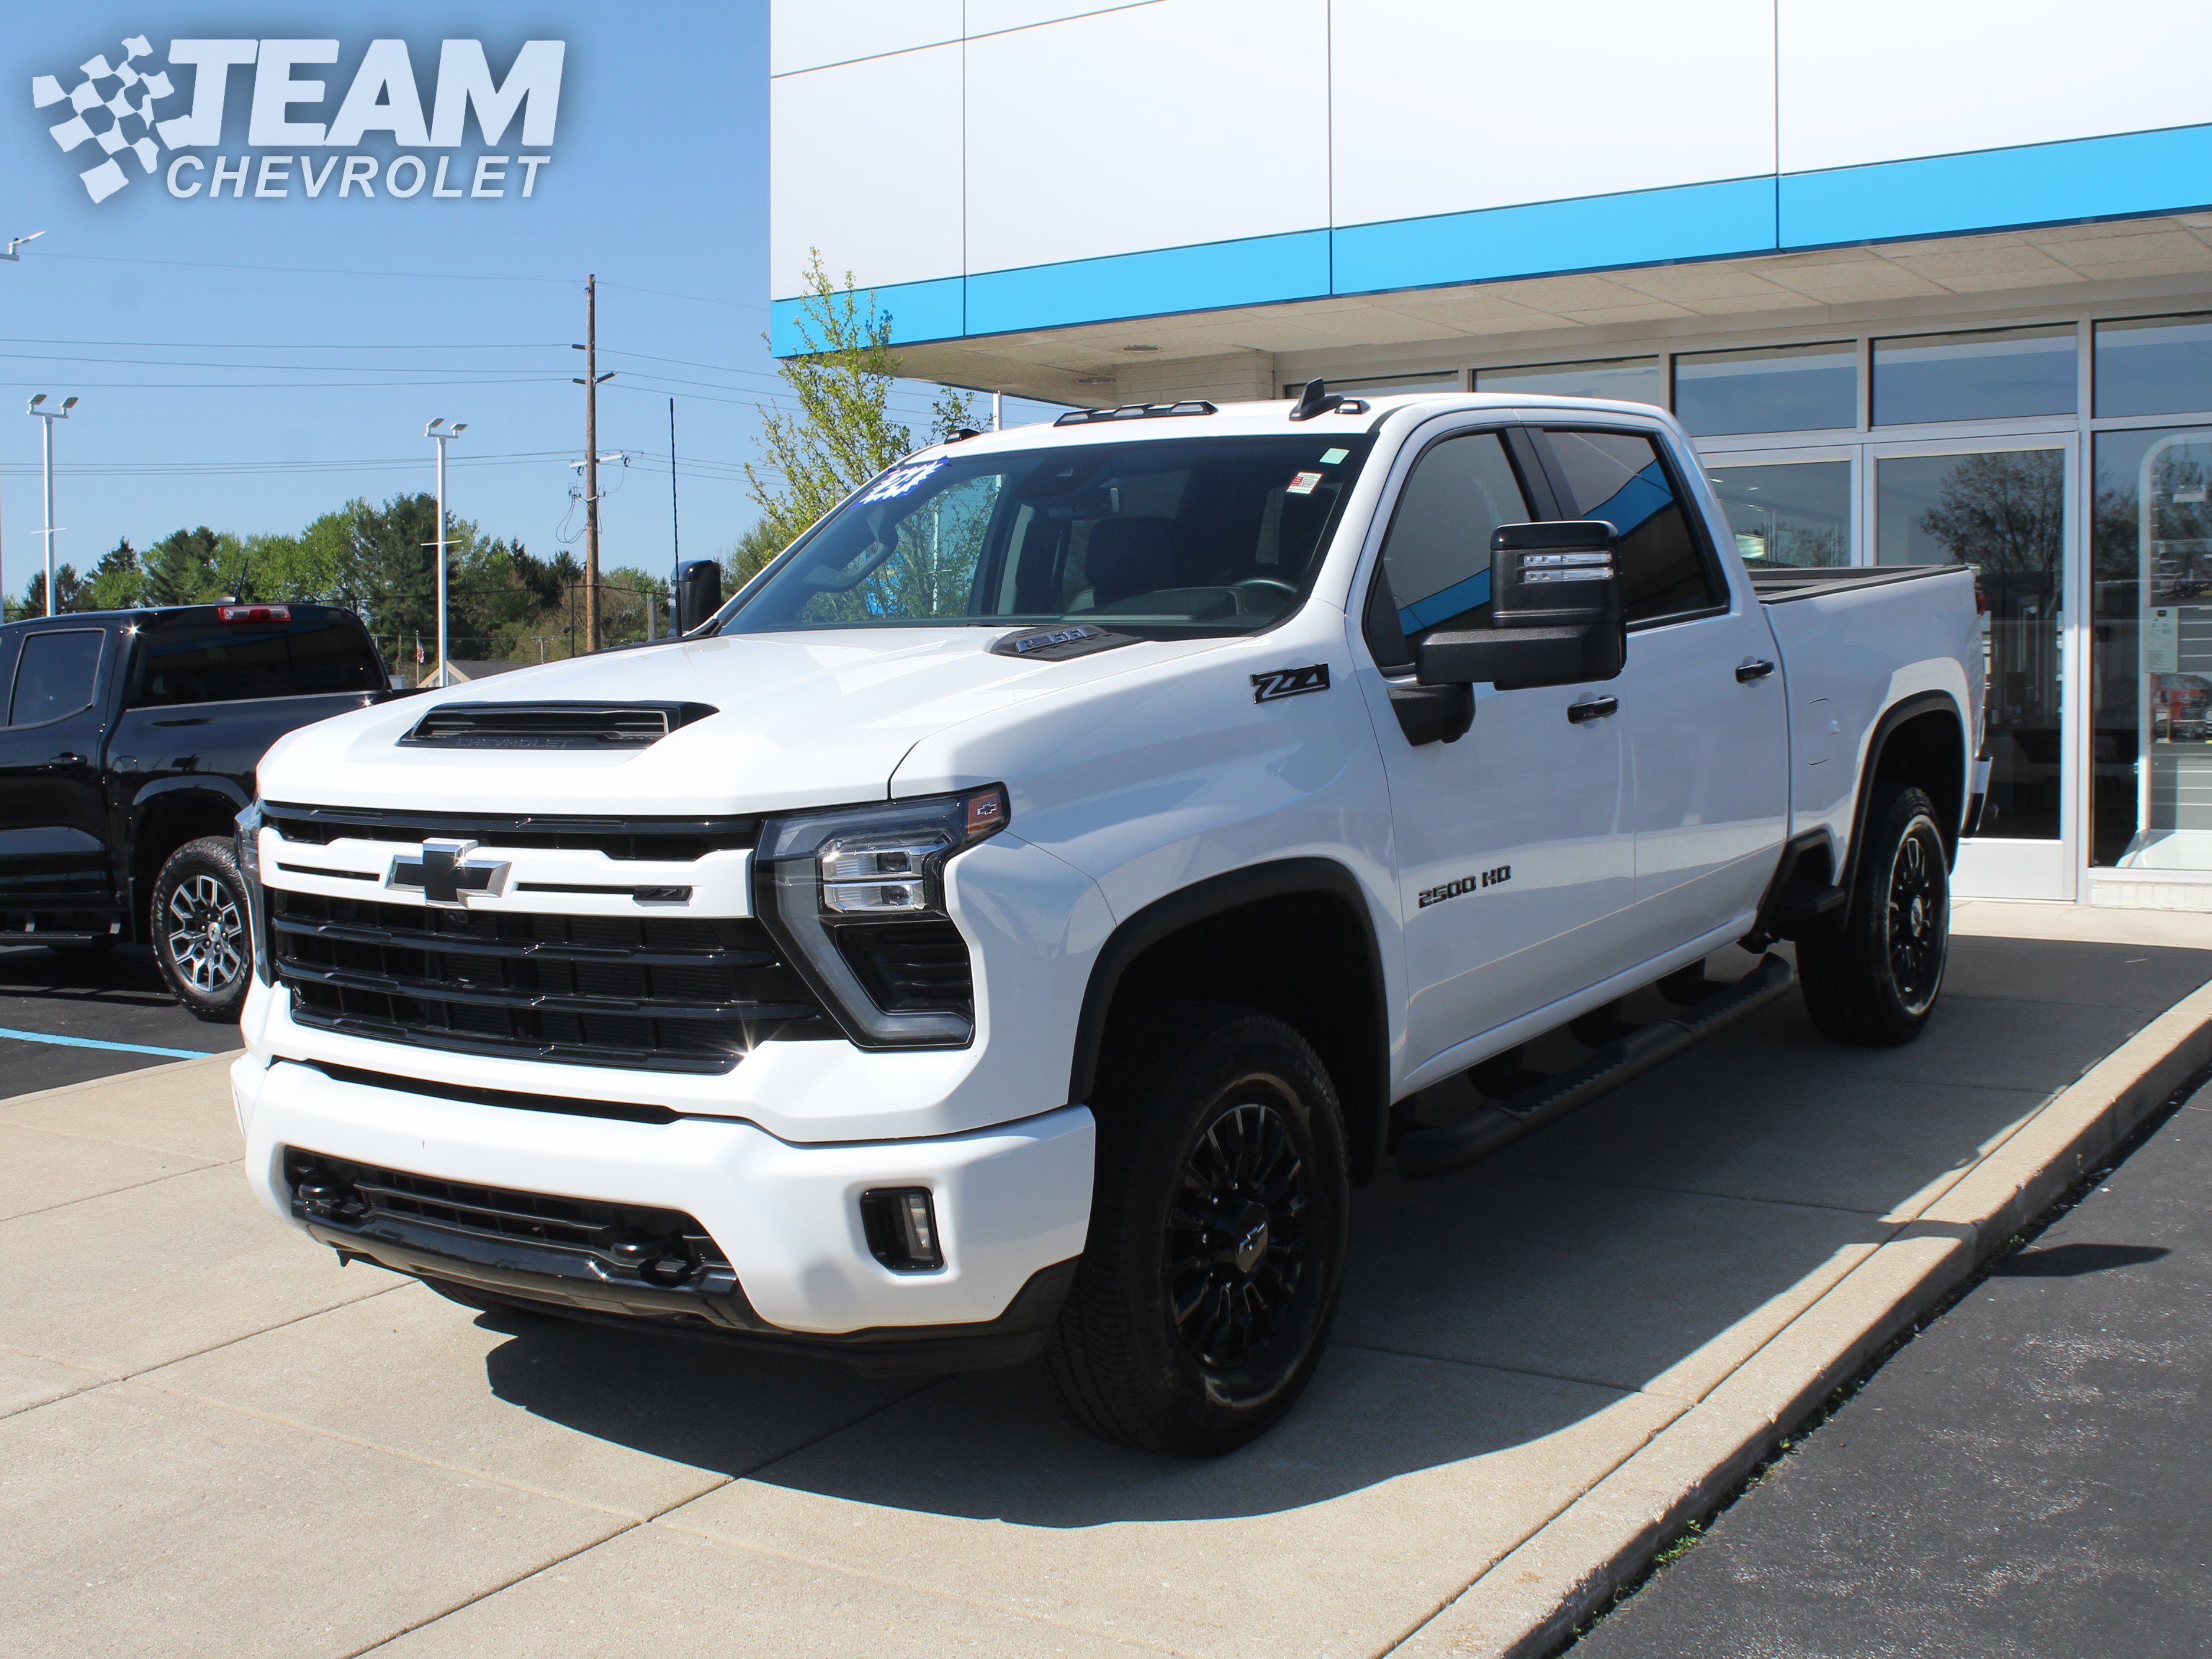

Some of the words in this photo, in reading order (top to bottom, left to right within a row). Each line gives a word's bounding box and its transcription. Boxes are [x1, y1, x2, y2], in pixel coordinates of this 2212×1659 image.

[1249, 662, 1331, 704] Z71
[1419, 876, 1477, 909] 2500
[1482, 865, 1511, 888] HD
